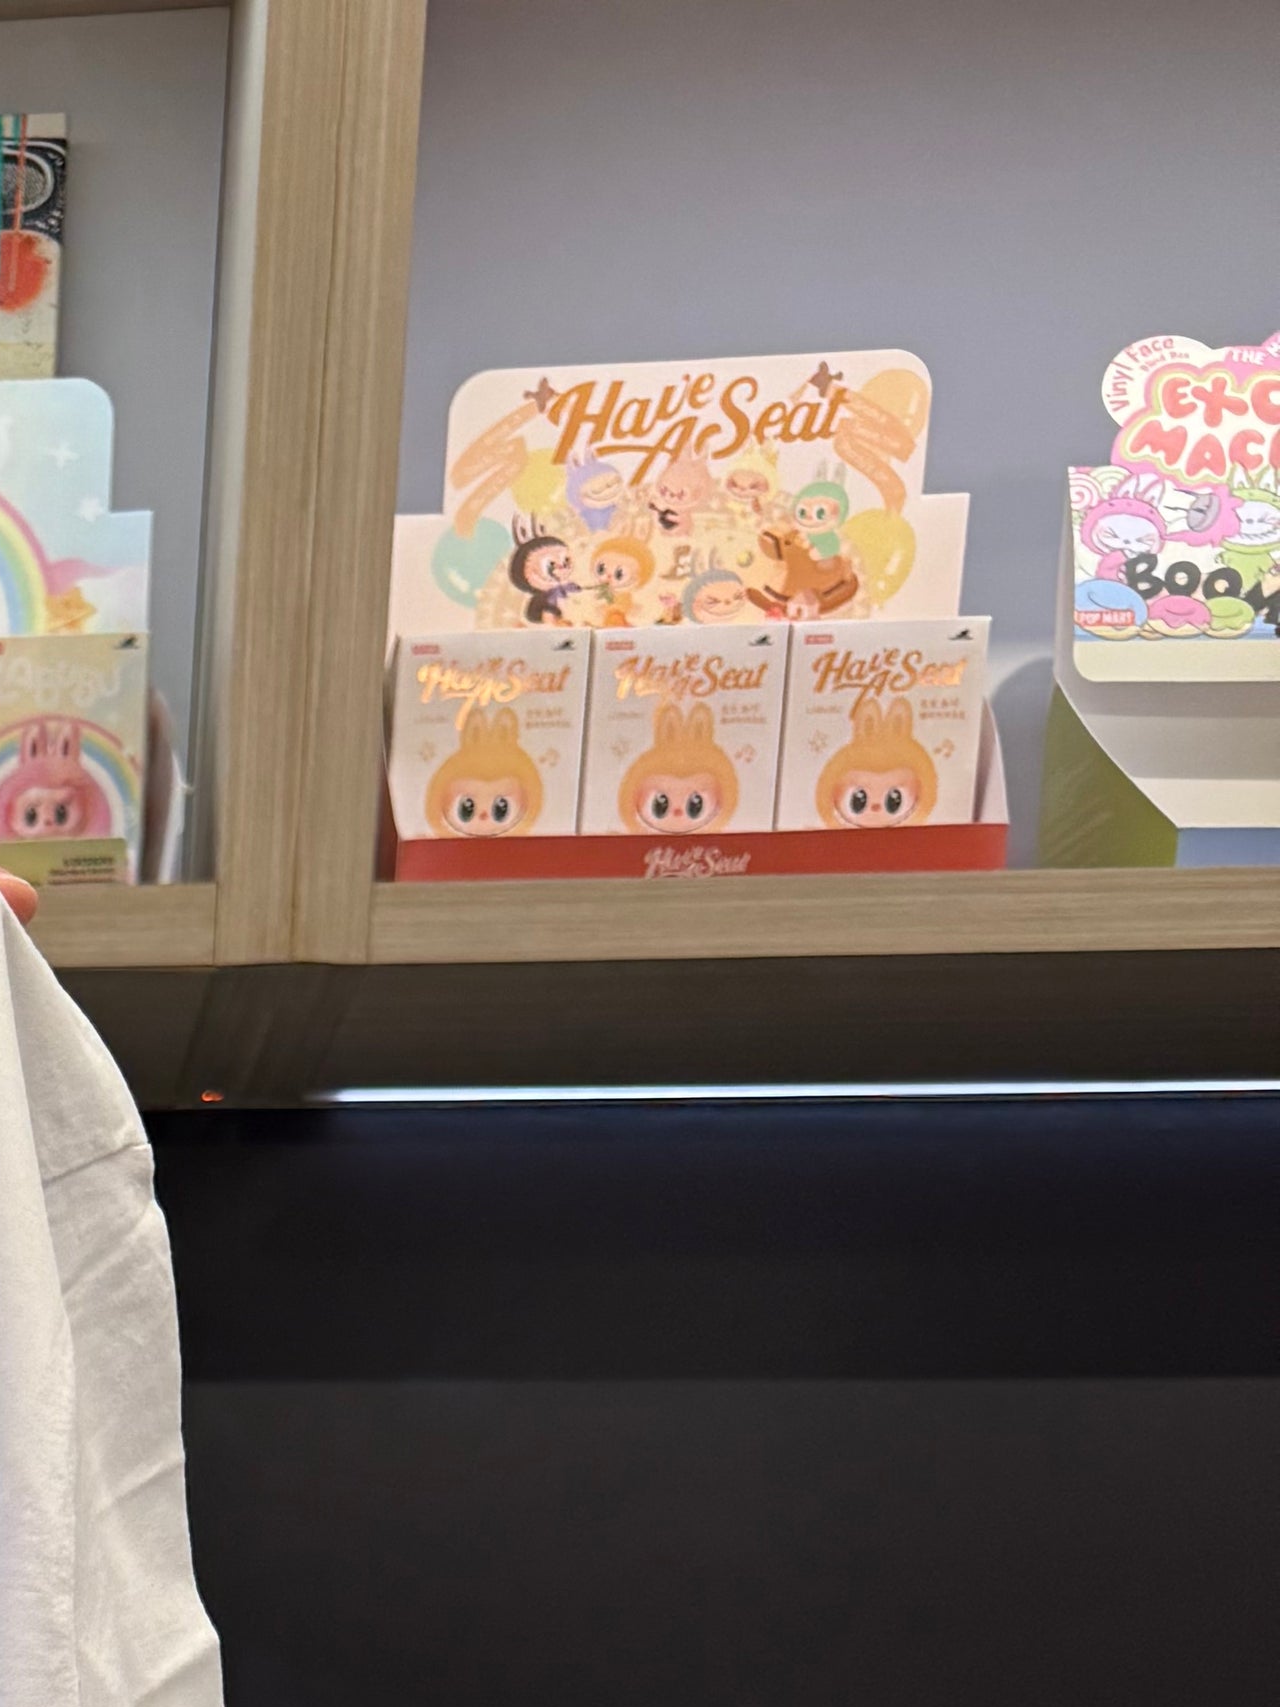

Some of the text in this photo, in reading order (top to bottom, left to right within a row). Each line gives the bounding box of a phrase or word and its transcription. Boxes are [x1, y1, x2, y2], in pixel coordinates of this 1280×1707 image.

[1128, 336, 1176, 368] Face
[1230, 348, 1266, 367] THE
[547, 372, 716, 466] Have
[710, 375, 849, 461] Seat
[1129, 419, 1280, 479] MAC
[690, 654, 769, 698] Seat
[811, 648, 900, 694] Have
[888, 649, 969, 693] Seat
